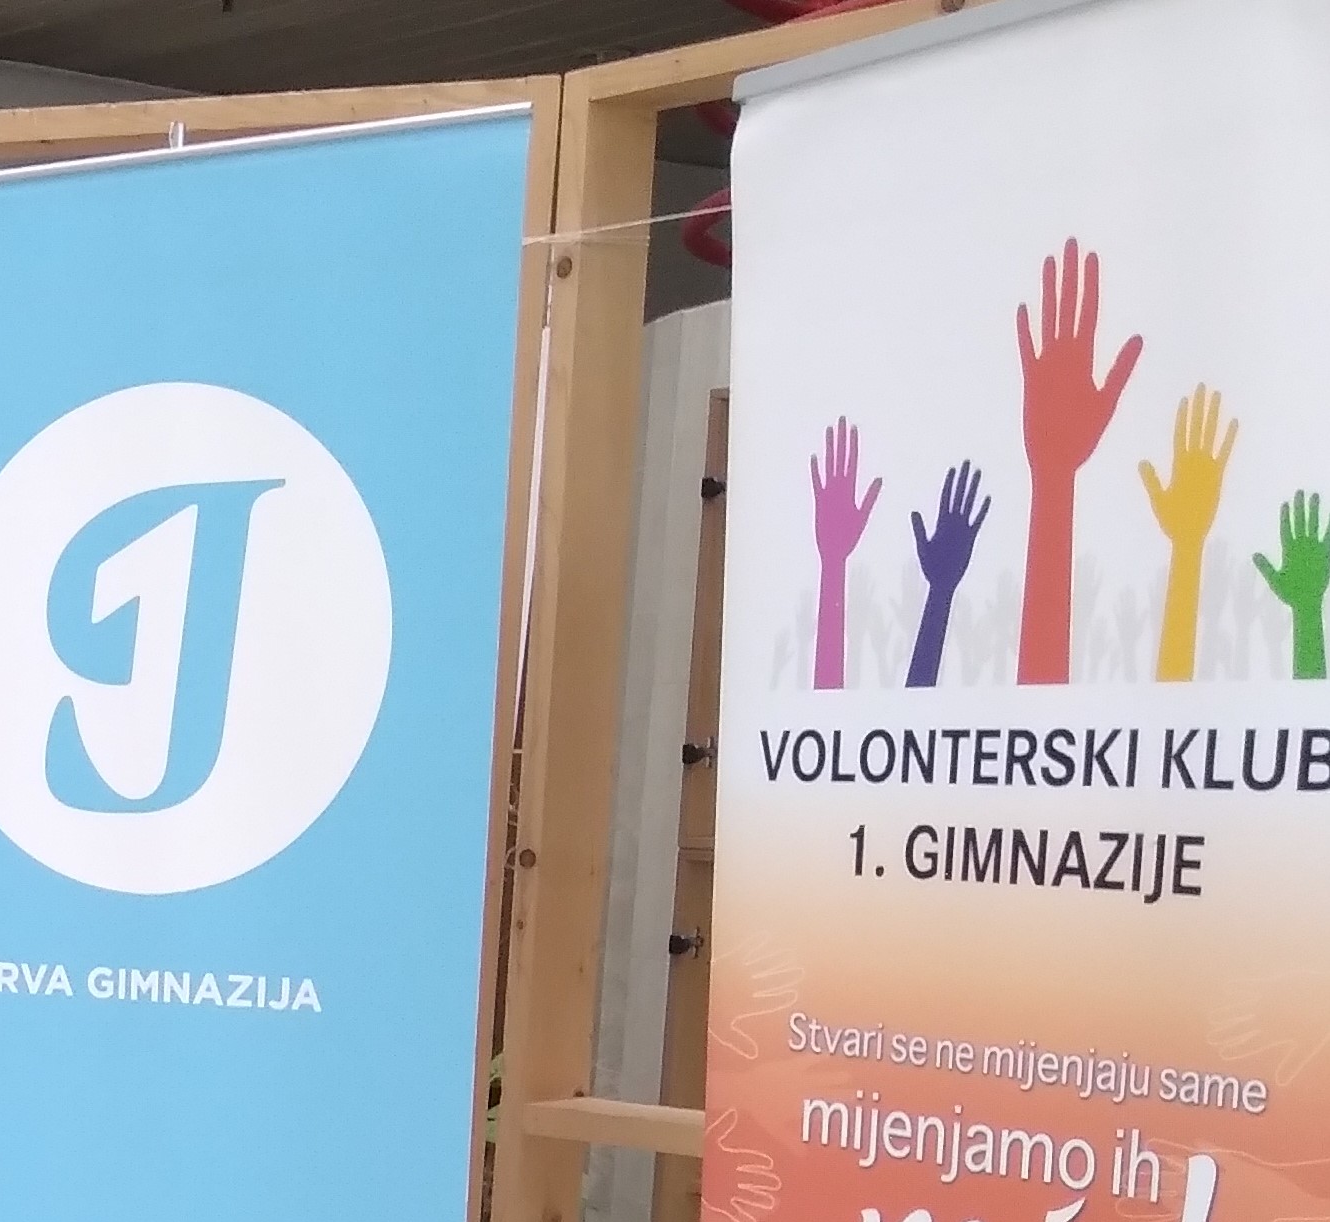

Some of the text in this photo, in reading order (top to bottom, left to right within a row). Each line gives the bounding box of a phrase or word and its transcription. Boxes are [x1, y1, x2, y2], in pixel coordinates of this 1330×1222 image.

[759, 728, 1330, 792] VOLONTERSKI KLUB
[848, 824, 1206, 904] 1. GIMNAZIJE
[87, 966, 322, 1013] GIMNAZIJA
[787, 1011, 1268, 1114] Stvari se ne mijenjaju same
[801, 1089, 1160, 1203] mijenjamo ih
